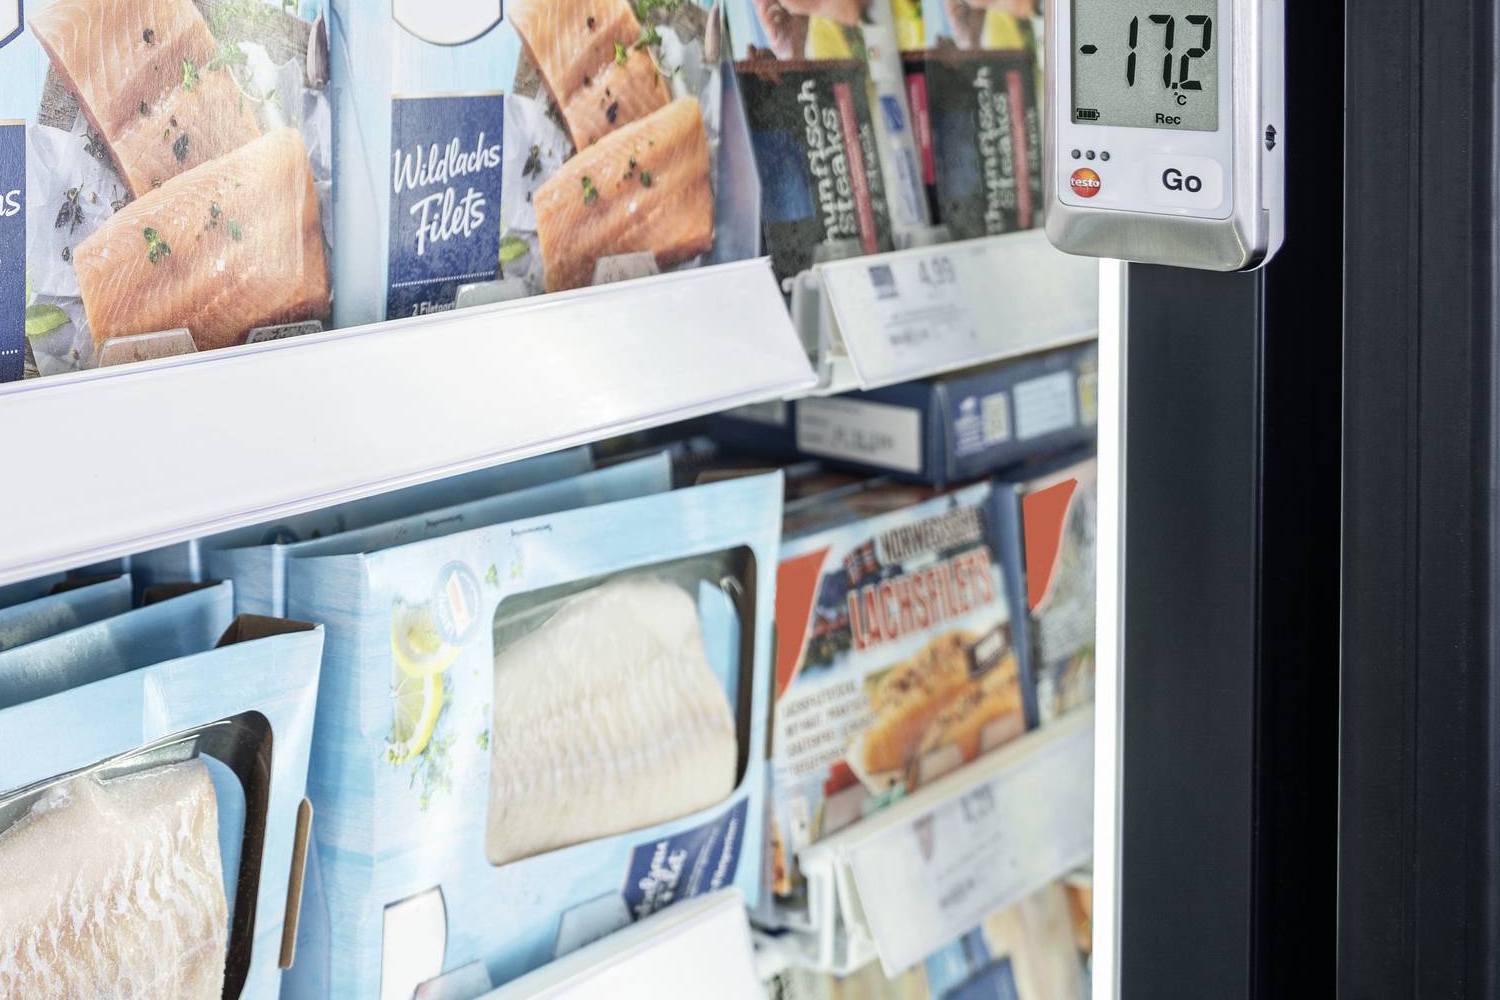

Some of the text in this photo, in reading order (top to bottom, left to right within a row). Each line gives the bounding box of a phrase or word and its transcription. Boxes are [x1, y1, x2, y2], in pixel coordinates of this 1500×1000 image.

[1155, 112, 1182, 126] Rec
[393, 131, 502, 194] Wildlachs
[1070, 176, 1101, 190] testo
[1161, 168, 1202, 194] Go
[410, 187, 487, 257] Filets
